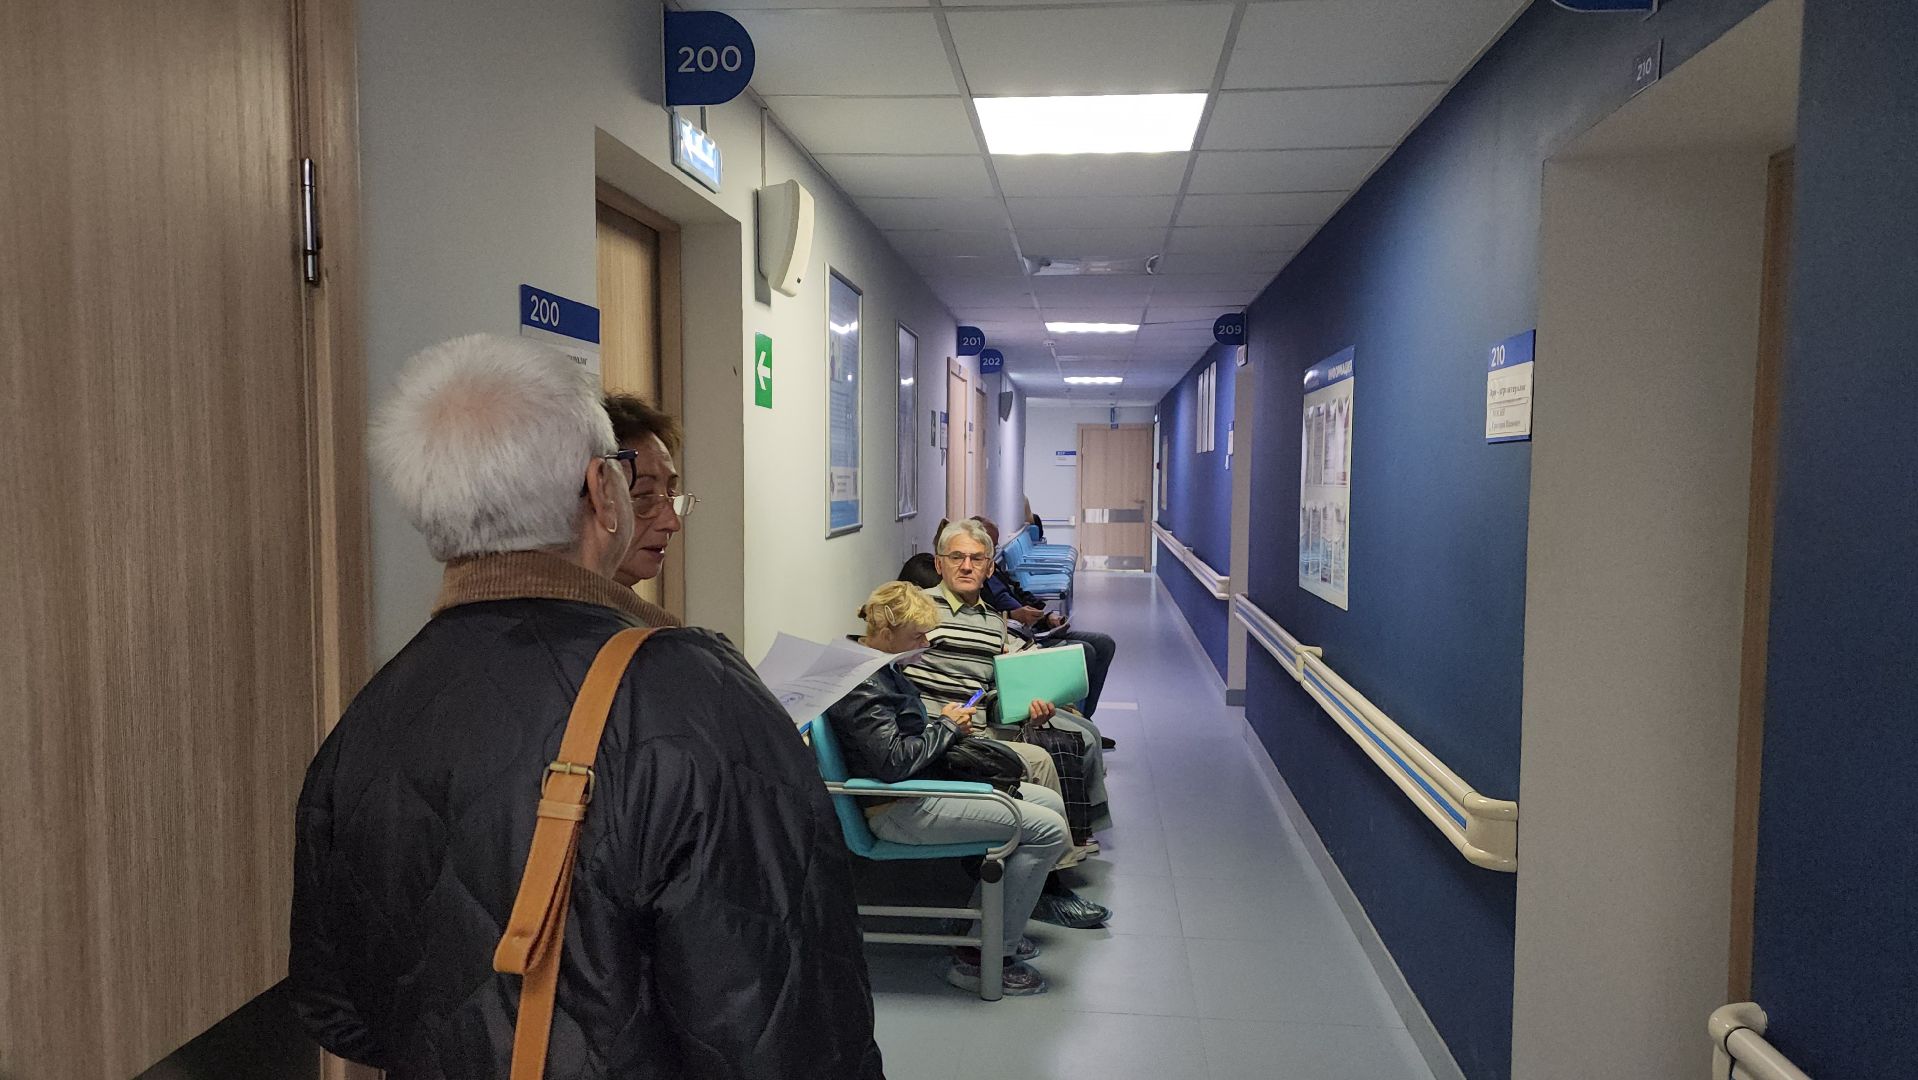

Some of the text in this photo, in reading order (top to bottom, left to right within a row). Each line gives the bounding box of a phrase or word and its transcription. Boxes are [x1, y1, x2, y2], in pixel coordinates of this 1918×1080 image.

[678, 45, 742, 73] 200
[1636, 56, 1652, 81] 210
[530, 295, 560, 327] 200
[962, 336, 981, 346] 201
[1217, 324, 1242, 335] 209
[982, 357, 1000, 366] 202
[1490, 344, 1505, 368] 210
